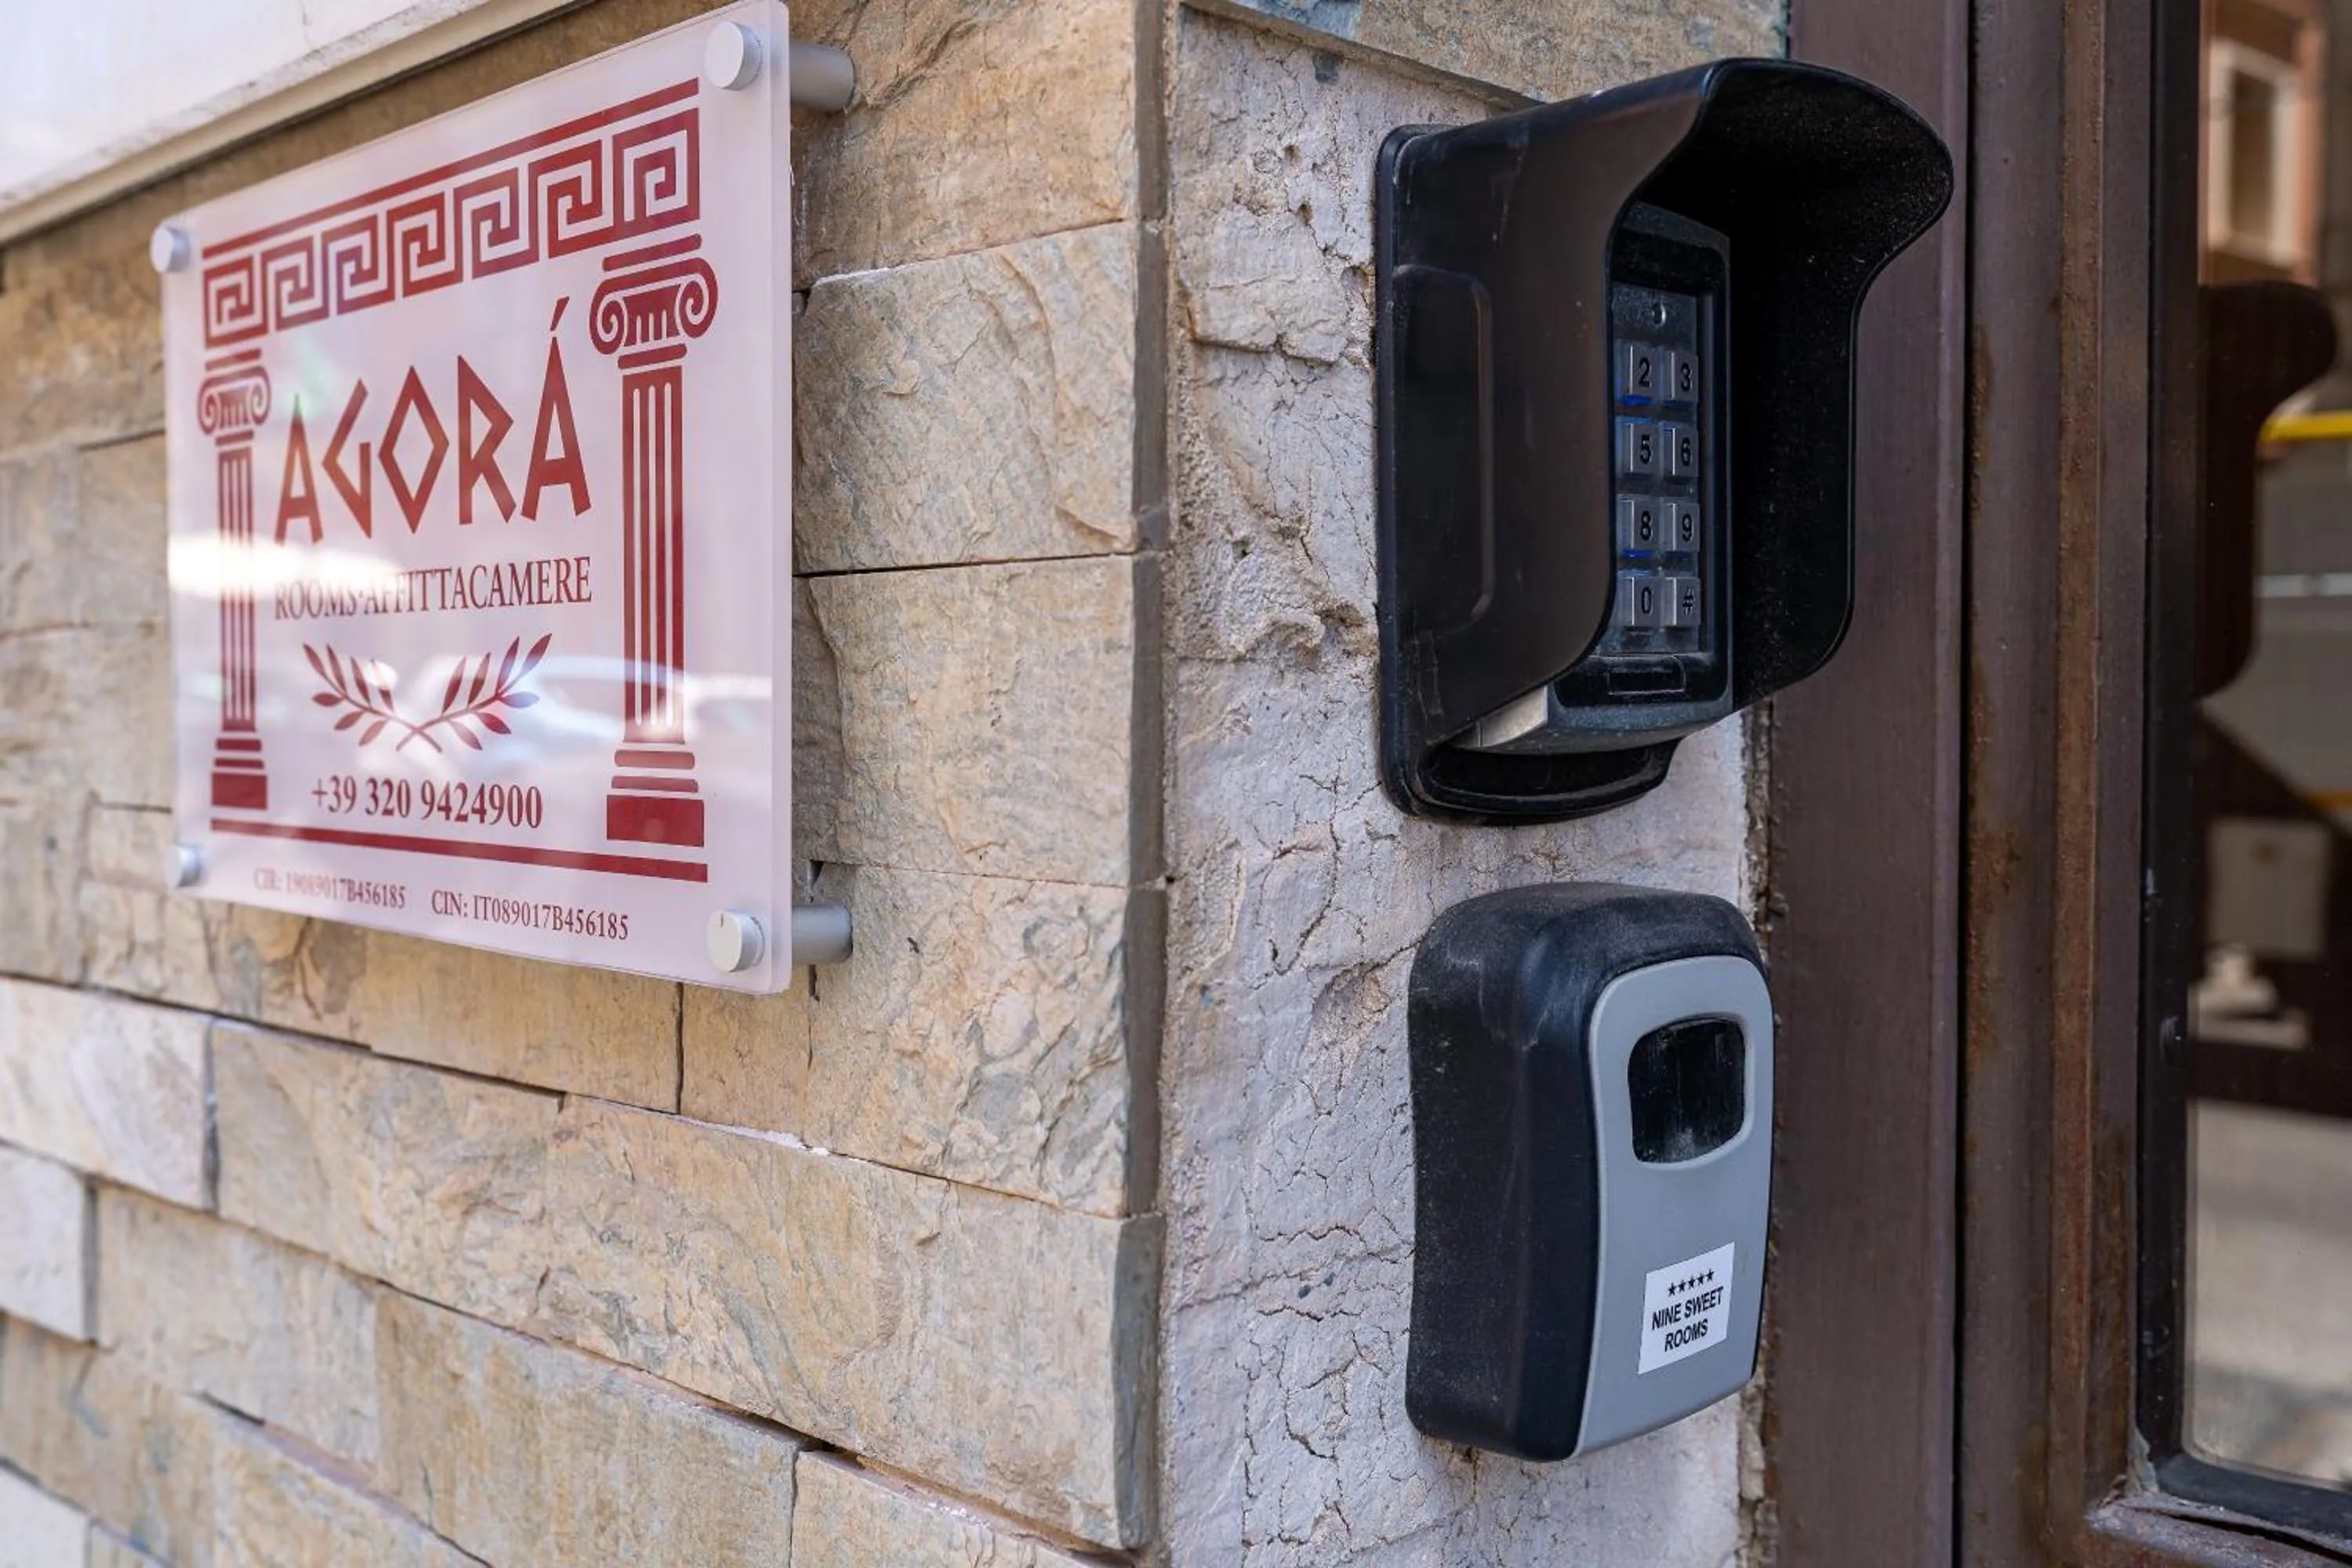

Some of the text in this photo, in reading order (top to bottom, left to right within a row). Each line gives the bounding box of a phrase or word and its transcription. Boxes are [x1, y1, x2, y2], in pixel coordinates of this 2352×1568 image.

[1639, 358, 1692, 392] 2 3
[274, 296, 593, 546] AGORÁ
[1639, 434, 1692, 467] 5 6
[1640, 510, 1693, 543] 8 9
[1641, 586, 1694, 615] 0 #
[311, 775, 543, 829] +39 320 9424900
[431, 890, 468, 917] CIN:
[473, 894, 629, 941] IT089017B456185
[1652, 1286, 1724, 1330] NINE SWEET
[1664, 1318, 1708, 1352] ROOMS
